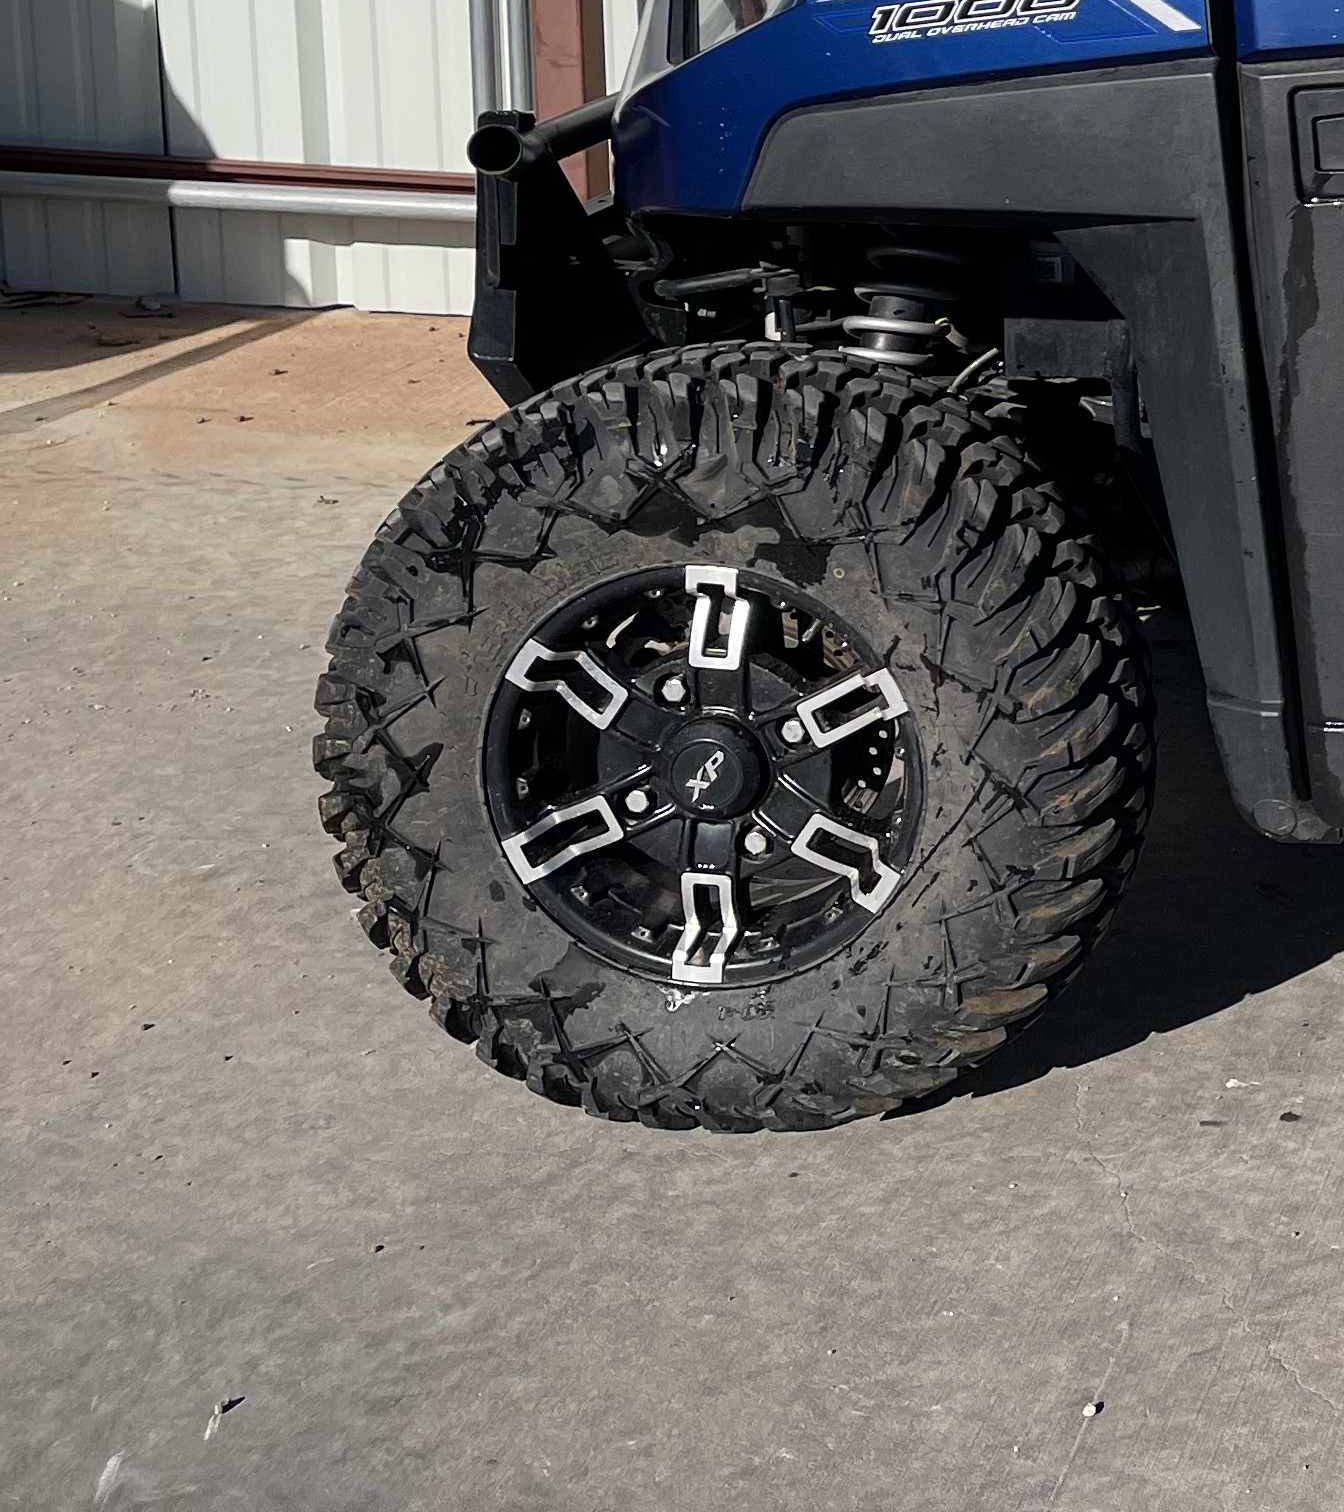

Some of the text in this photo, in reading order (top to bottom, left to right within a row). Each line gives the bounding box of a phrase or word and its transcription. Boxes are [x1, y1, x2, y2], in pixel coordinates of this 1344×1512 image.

[871, 11, 1077, 44] DUAL OVERHEAD CAM
[685, 749, 725, 803] XP
